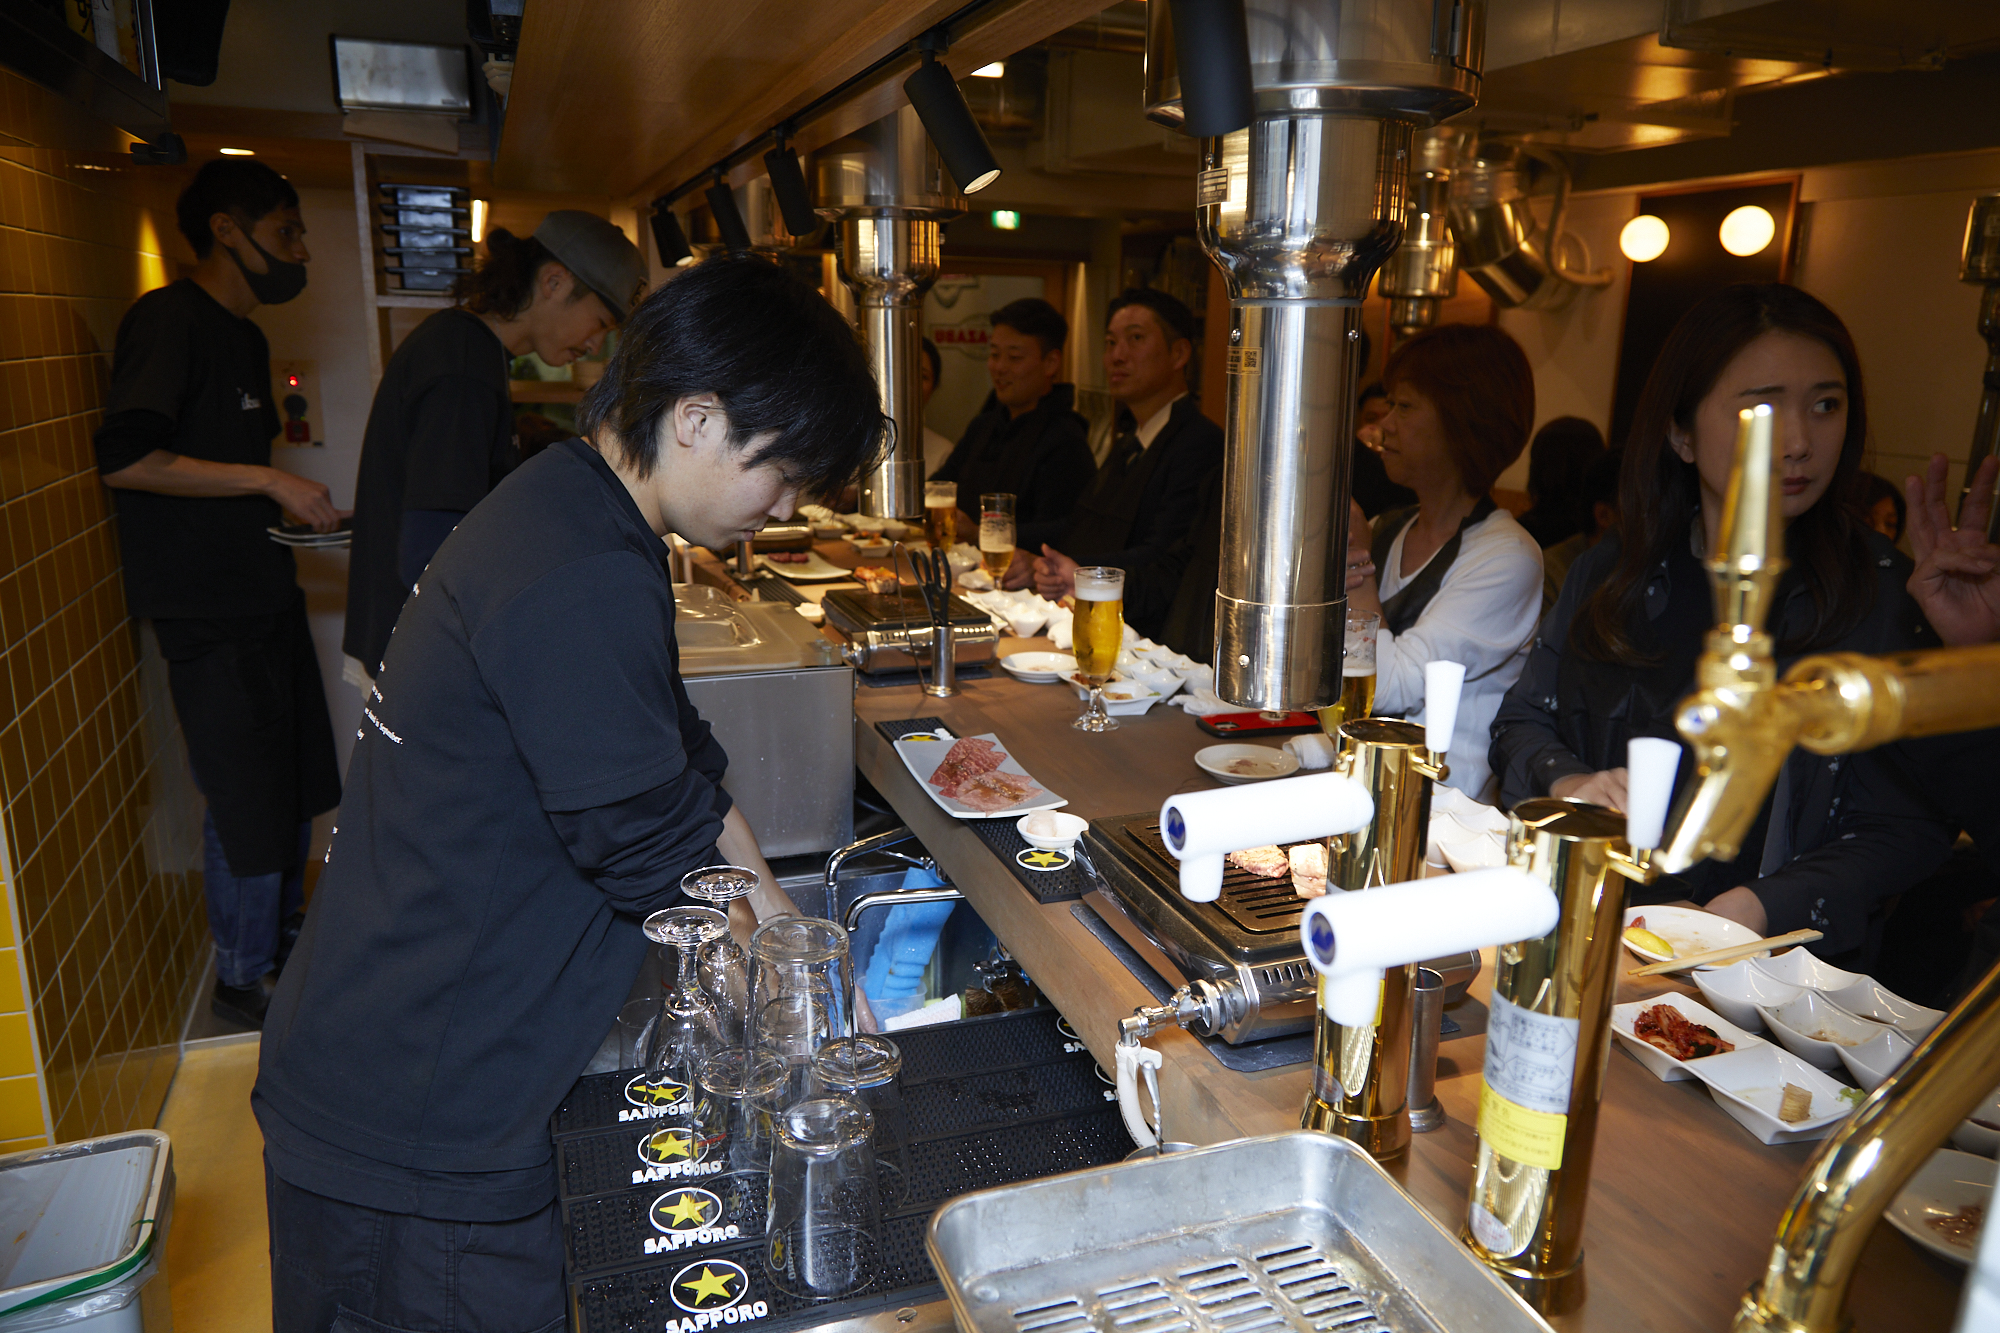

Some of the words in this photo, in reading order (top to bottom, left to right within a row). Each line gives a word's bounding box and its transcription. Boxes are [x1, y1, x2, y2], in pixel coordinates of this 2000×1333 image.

[632, 1159, 723, 1185] SAPPORO
[644, 1224, 740, 1255] SAPPORO
[665, 1300, 769, 1333] SAPPORO
